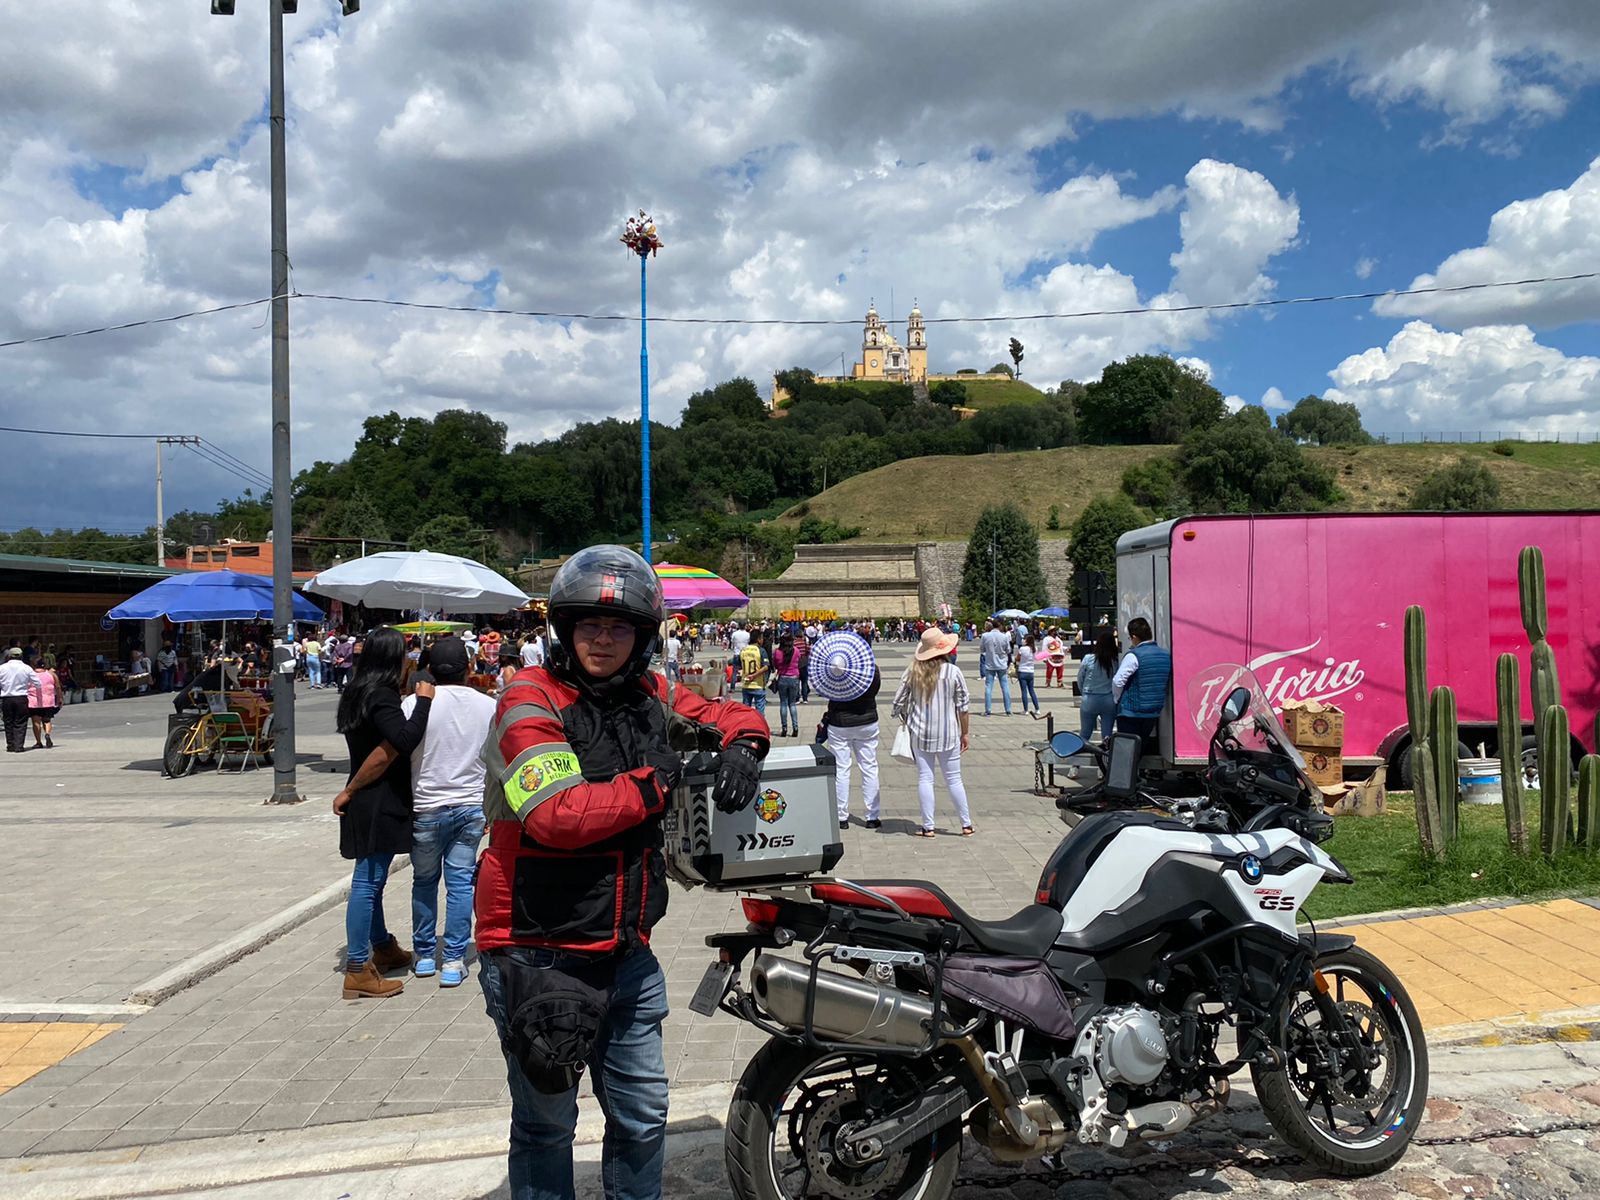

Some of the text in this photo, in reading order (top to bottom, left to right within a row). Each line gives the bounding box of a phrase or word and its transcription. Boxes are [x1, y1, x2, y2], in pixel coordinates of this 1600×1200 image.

[780, 609, 837, 621] SAN PEDRO
[742, 659, 757, 676] 10
[1197, 636, 1365, 731] Vtoria
[542, 758, 573, 774] RRM
[768, 834, 795, 848] GS
[1259, 895, 1295, 911] GS
